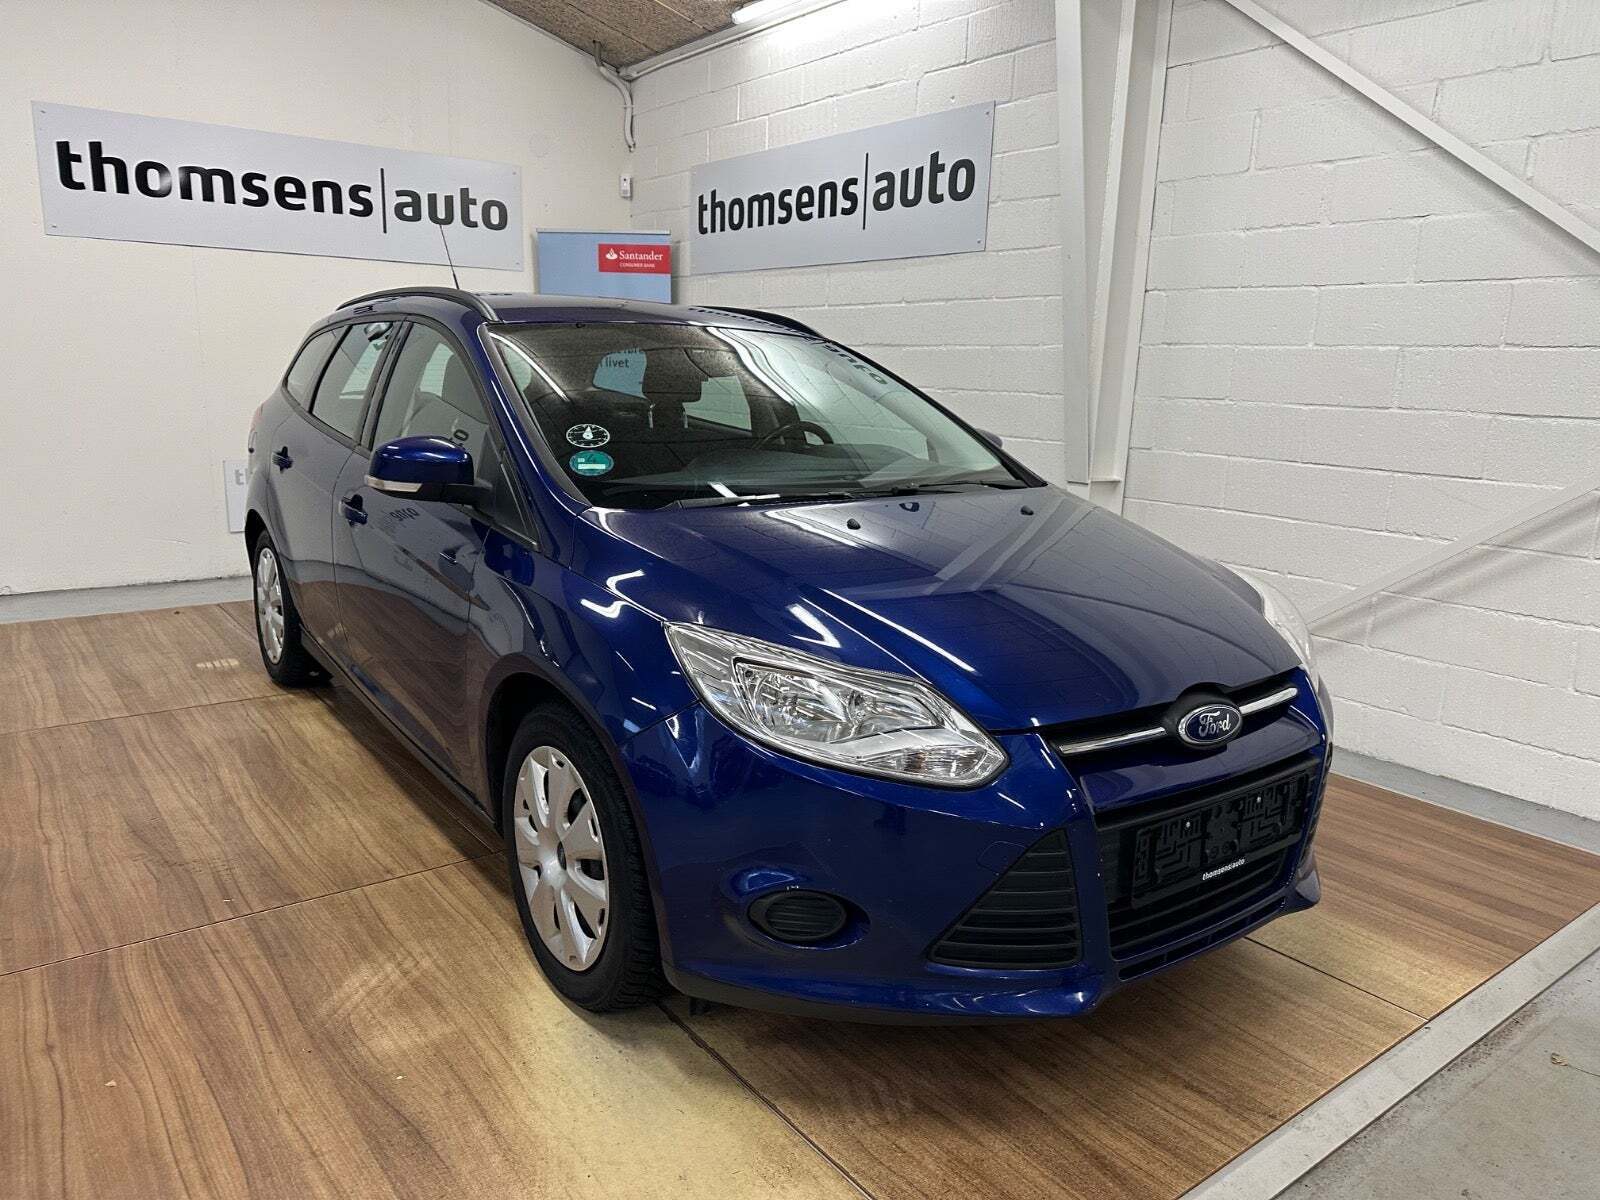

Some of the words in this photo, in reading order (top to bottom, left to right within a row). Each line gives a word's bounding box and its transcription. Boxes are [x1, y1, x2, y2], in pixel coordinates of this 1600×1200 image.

[55, 139, 374, 218] thomsens
[393, 186, 508, 232] auto
[697, 177, 859, 235] thomsens
[872, 150, 976, 212] auto
[618, 249, 664, 261] Santander
[1198, 710, 1232, 738] Ford
